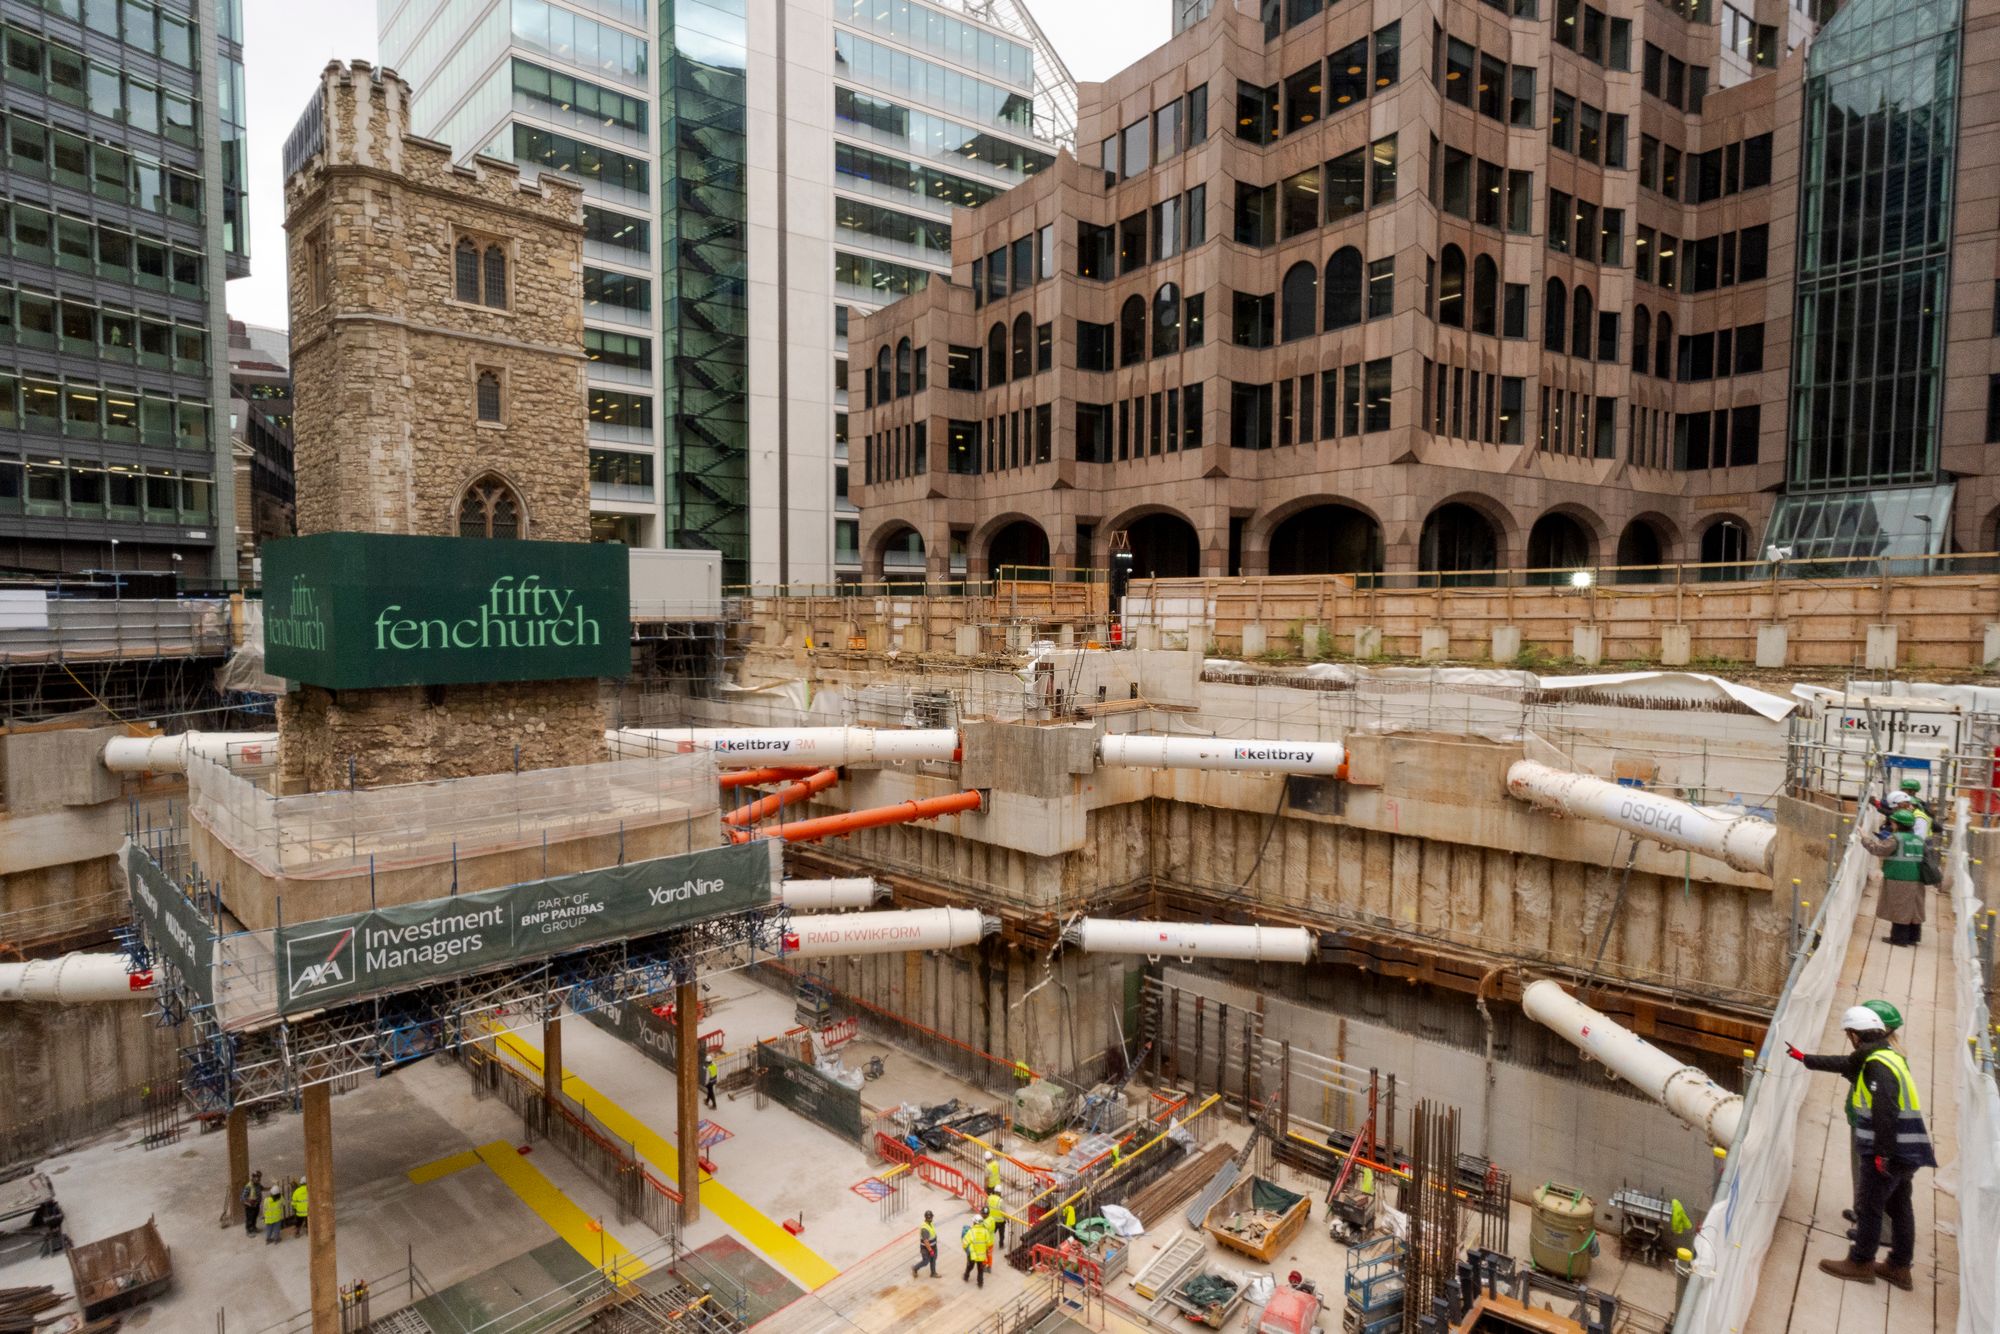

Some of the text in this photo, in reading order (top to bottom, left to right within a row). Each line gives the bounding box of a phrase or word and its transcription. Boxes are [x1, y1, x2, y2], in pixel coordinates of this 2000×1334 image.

[489, 574, 575, 624] fifty
[374, 604, 601, 650] fenchurch
[728, 739, 791, 752] keltbray
[1248, 748, 1314, 763] keltbray
[537, 893, 589, 911] PART OF
[648, 878, 725, 906] YardNine
[365, 905, 504, 949] Investment
[521, 902, 605, 927] BNP PARIBAS
[541, 917, 587, 934] GROUP
[807, 926, 921, 944] RMD KWIKFORM
[366, 934, 483, 973] Managers
[291, 959, 344, 993] AXA
[638, 1015, 677, 1059] YardN
